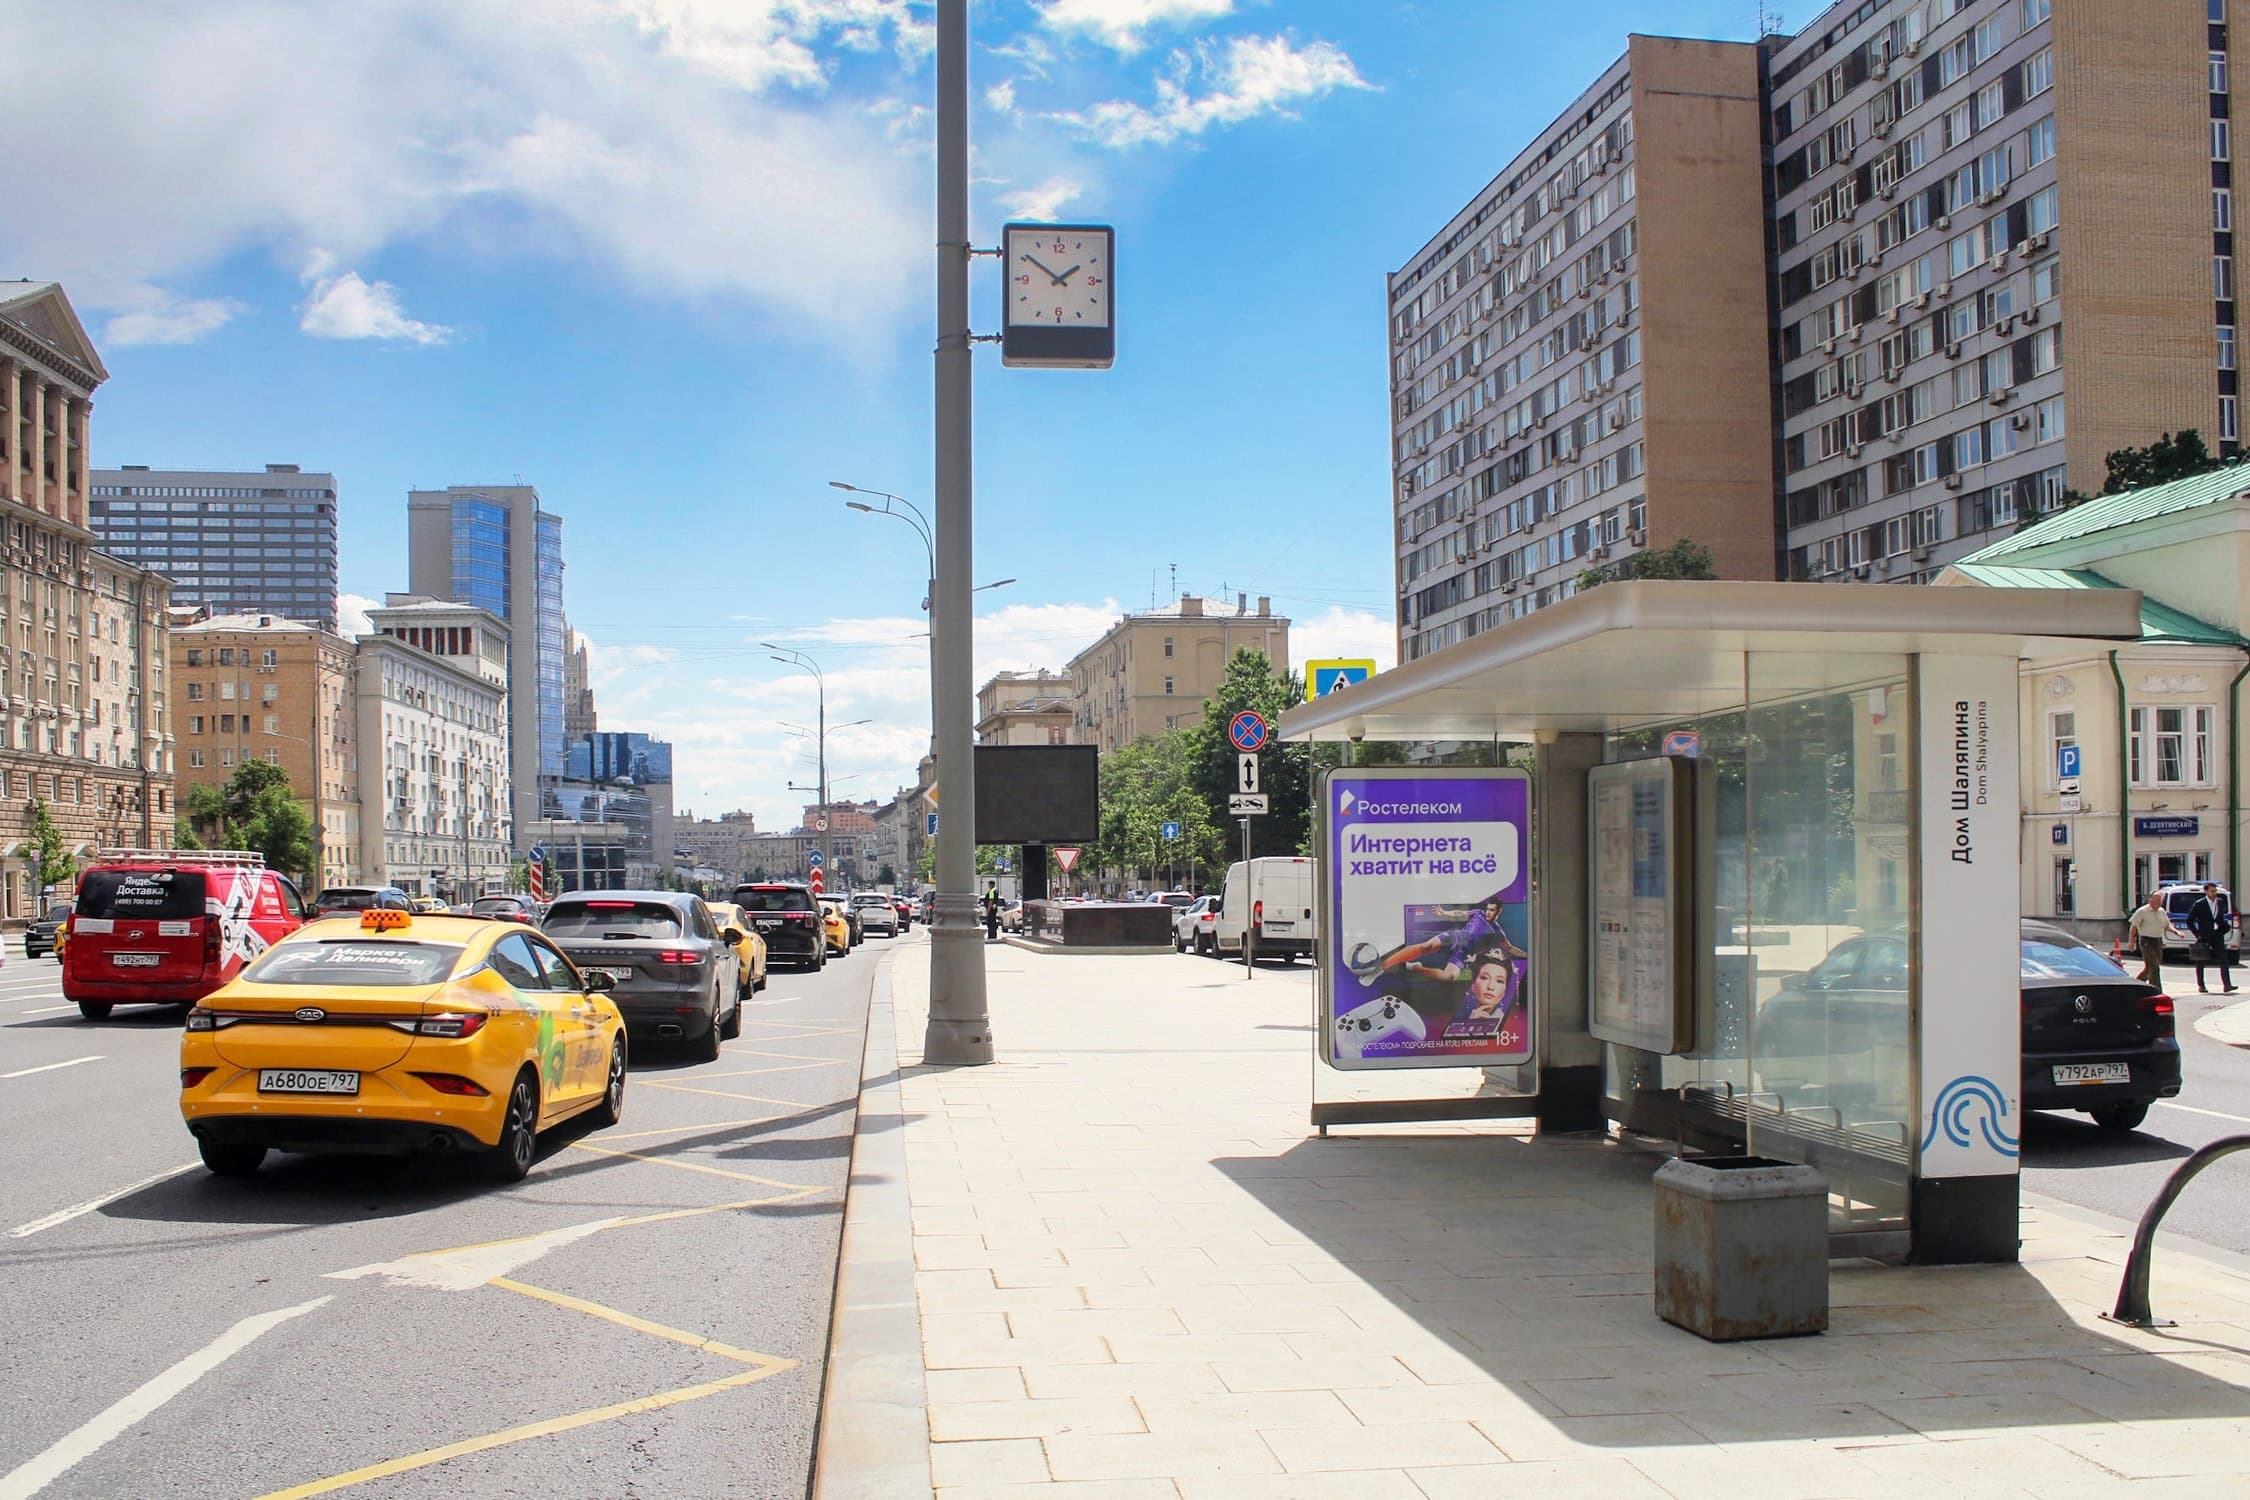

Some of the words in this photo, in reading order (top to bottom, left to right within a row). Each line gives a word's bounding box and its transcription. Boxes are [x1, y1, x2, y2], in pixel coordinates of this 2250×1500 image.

[1053, 243, 1066, 254] 12
[1021, 274, 1030, 285] 9
[1088, 276, 1097, 287] 3
[1055, 306, 1063, 317] 6
[1976, 700, 1989, 772] Shalyapina
[1951, 700, 1969, 811] Шаляпина
[2064, 751, 2075, 774] P
[1976, 774, 1988, 806] Dom
[1358, 799, 1463, 816] Ростелеком
[1951, 817, 1973, 865] Дом
[2055, 830, 2062, 840] 17
[1350, 833, 1473, 858] Интернета
[1350, 860, 1424, 876] хватит
[1429, 859, 1454, 875] на
[1459, 853, 1497, 874] всё
[116, 885, 165, 895] Доставка
[325, 955, 425, 965] Деливери
[332, 948, 408, 957] Маркет
[1496, 1030, 1520, 1047] 18+
